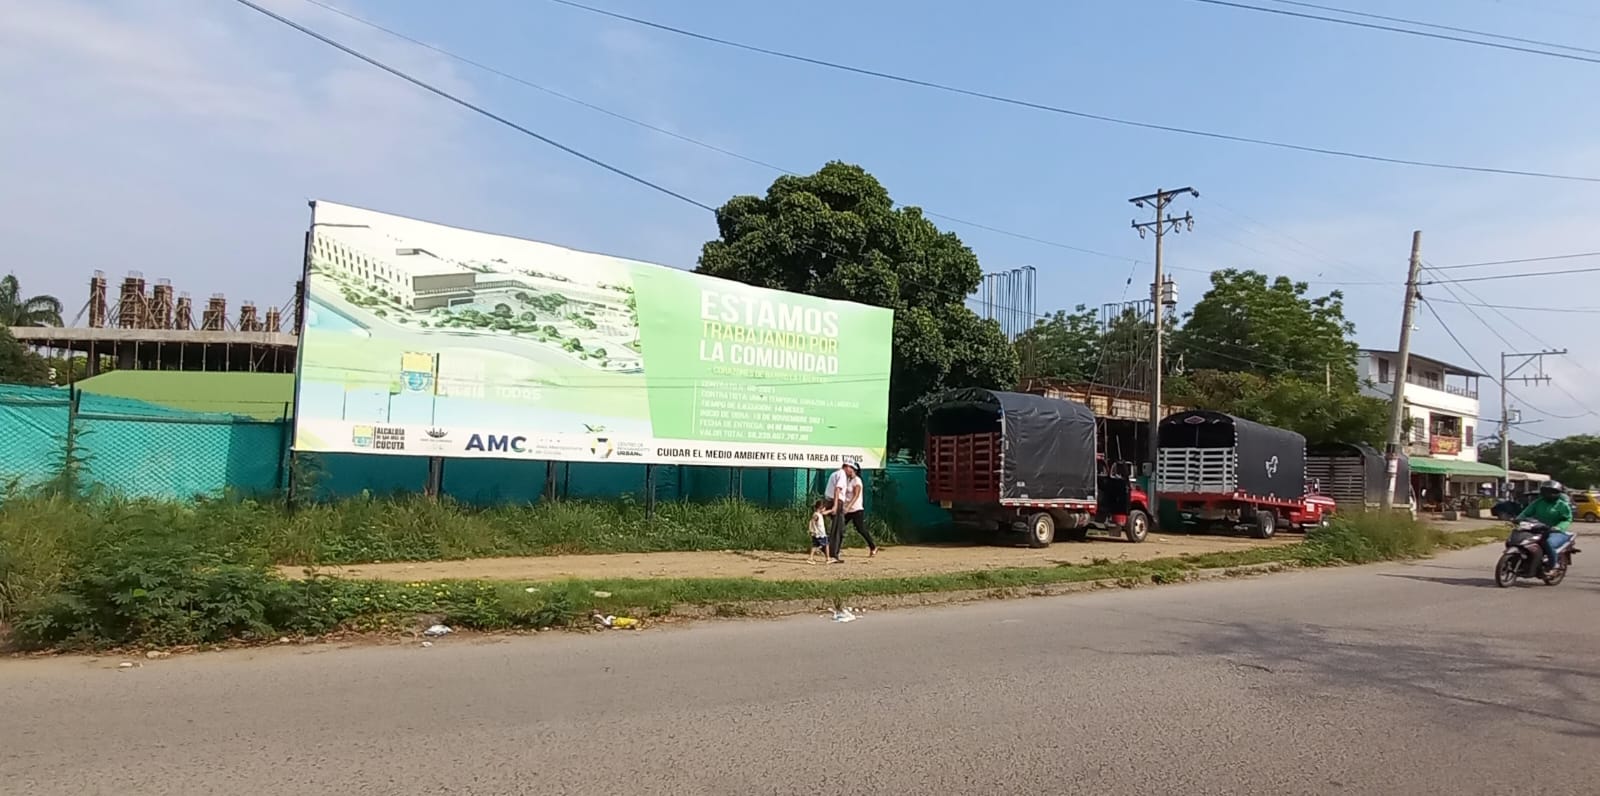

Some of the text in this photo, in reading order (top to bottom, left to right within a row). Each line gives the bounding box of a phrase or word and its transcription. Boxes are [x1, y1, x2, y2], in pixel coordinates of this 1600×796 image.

[700, 289, 839, 338] ESTAMOS
[702, 320, 837, 355] TRABAJANDO POR
[700, 339, 839, 375] LA COMUNIDAD
[657, 447, 690, 458] CUIDAR
[693, 449, 702, 458] EL
[705, 450, 732, 459] MEDIO
[734, 451, 775, 461] AMBIENTE
[776, 453, 787, 461] ES
[788, 453, 804, 462] UNA
[806, 454, 829, 463] TAREA
[830, 454, 839, 463] DE
